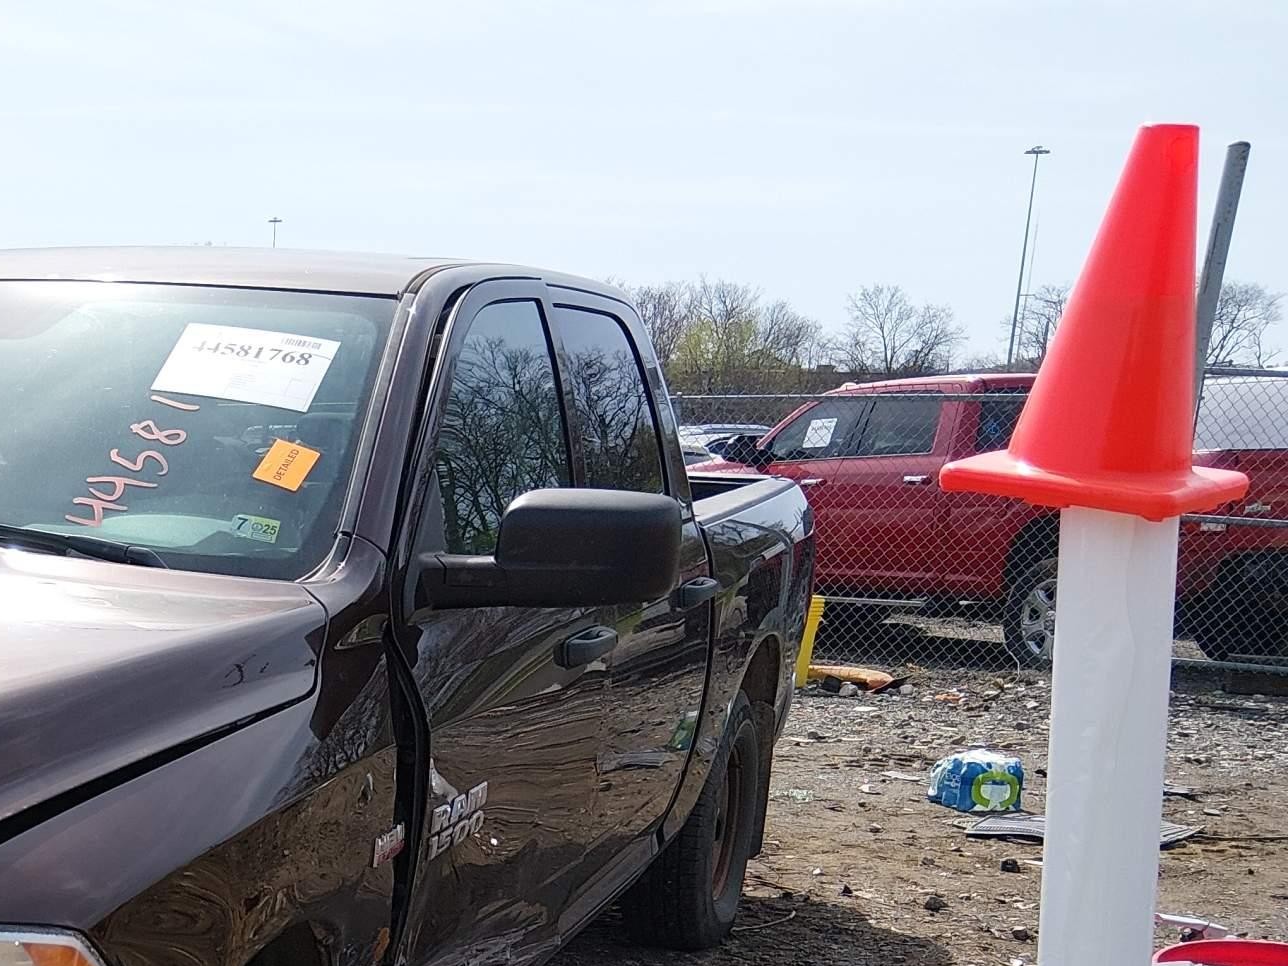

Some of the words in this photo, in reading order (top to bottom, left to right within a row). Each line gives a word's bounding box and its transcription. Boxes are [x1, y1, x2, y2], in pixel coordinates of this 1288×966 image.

[192, 340, 313, 366] 44581768
[64, 394, 201, 528] 44581
[273, 448, 300, 481] DETAILED
[237, 516, 249, 530] 7
[262, 524, 278, 536] 25
[430, 781, 488, 834] RAM
[428, 810, 485, 861] 1500
